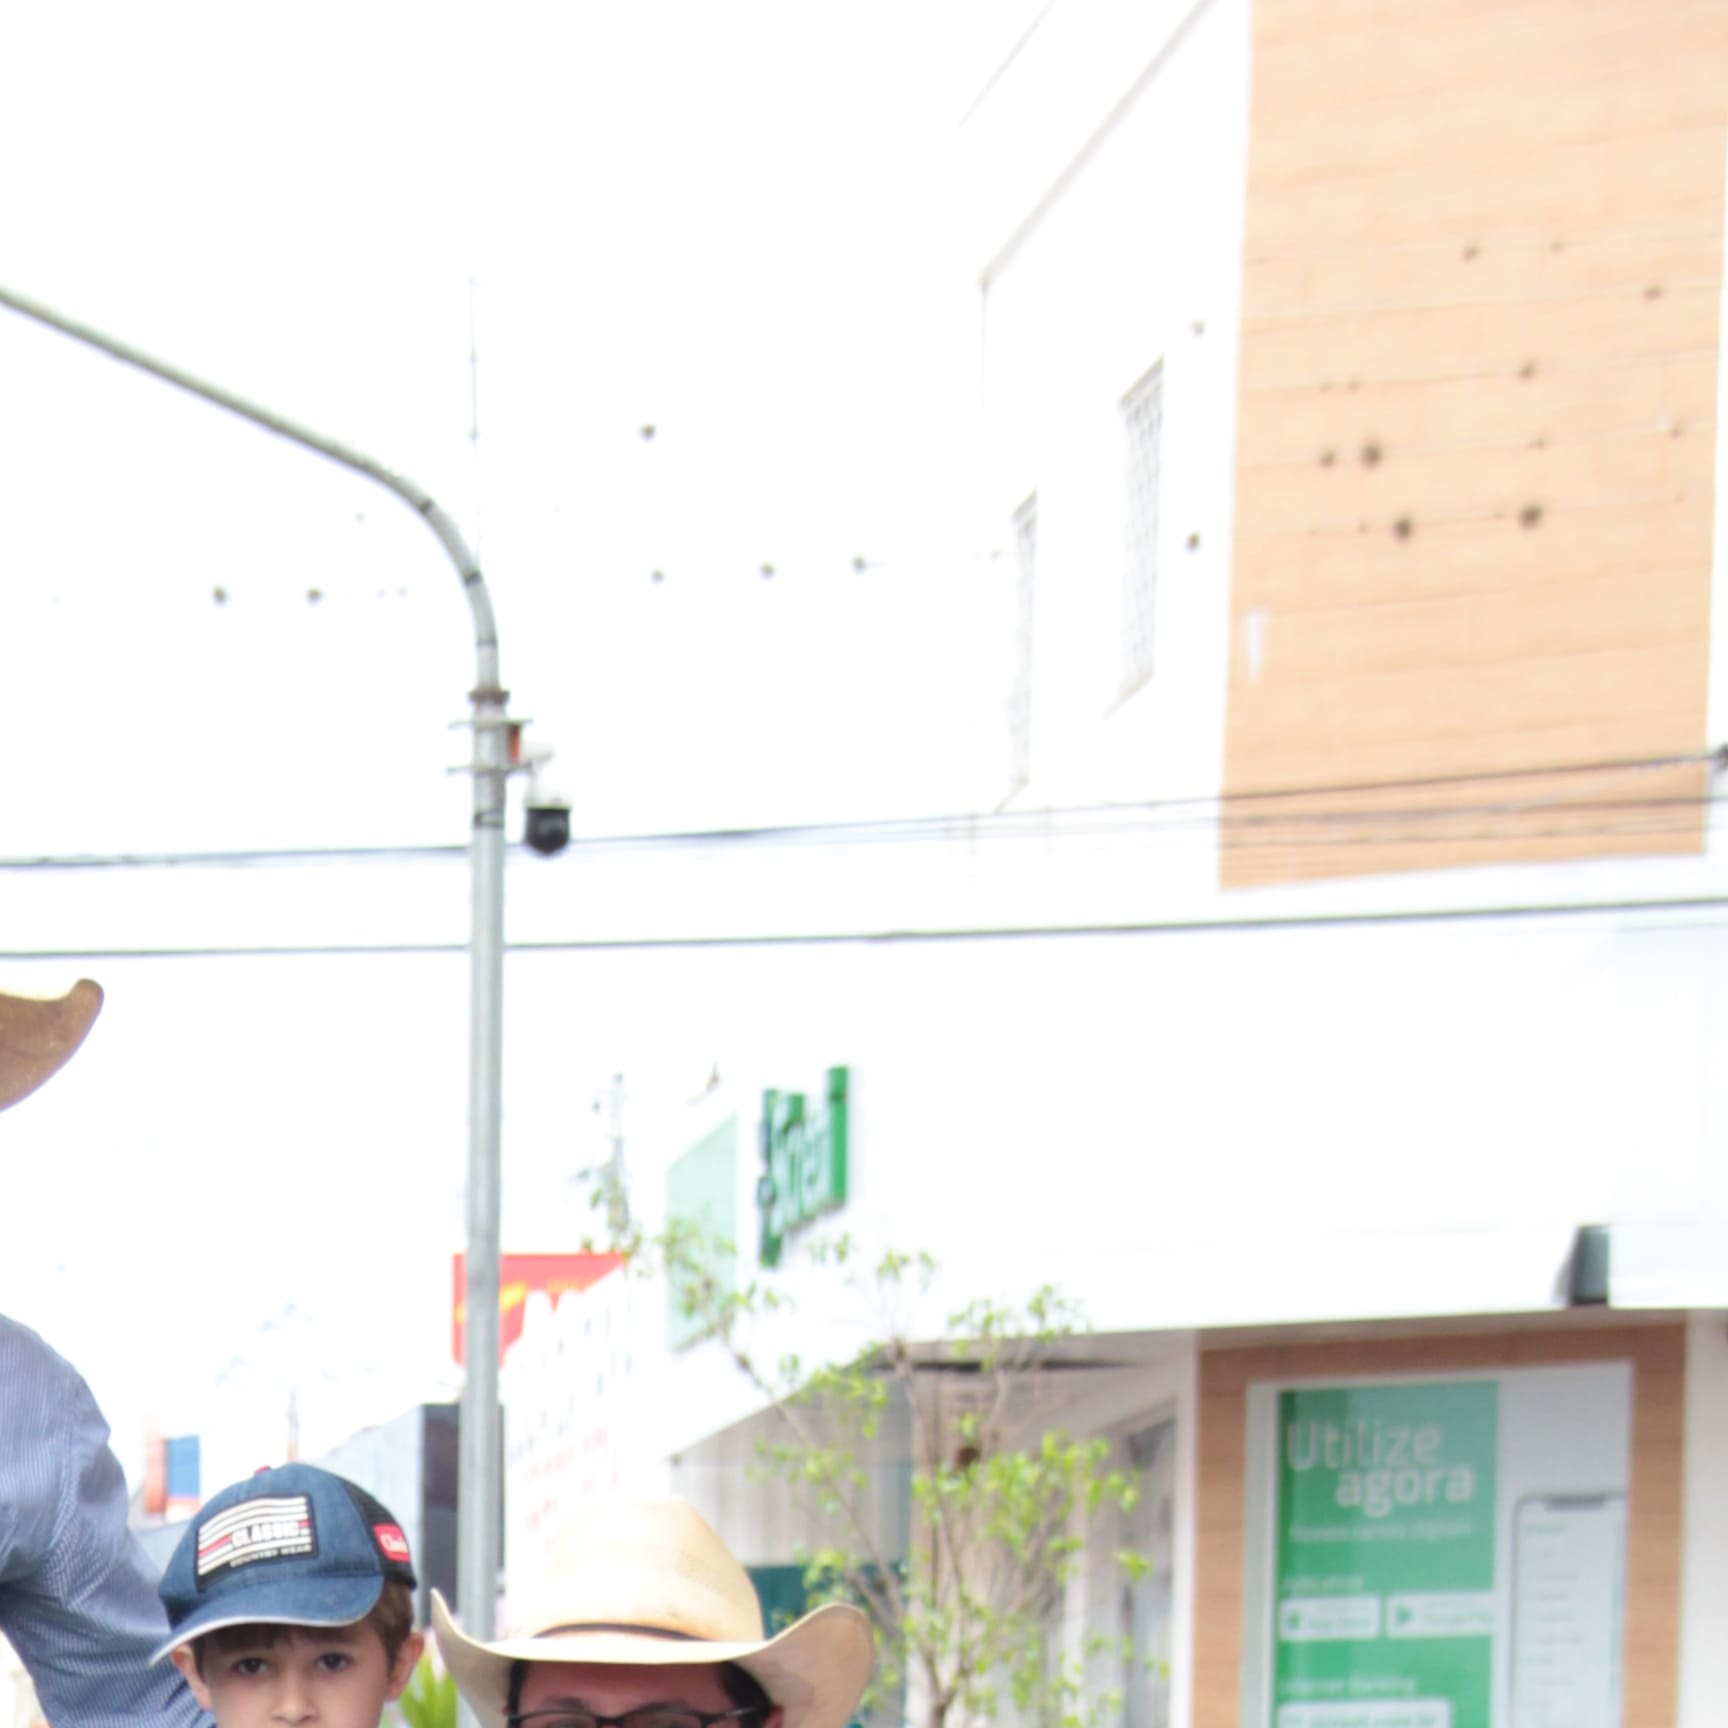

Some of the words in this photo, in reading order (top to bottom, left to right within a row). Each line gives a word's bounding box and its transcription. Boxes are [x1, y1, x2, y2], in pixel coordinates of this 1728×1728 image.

[1287, 1418, 1443, 1471] Utilize
[1335, 1465, 1474, 1518] agora
[232, 1521, 299, 1548] CLASSIC
